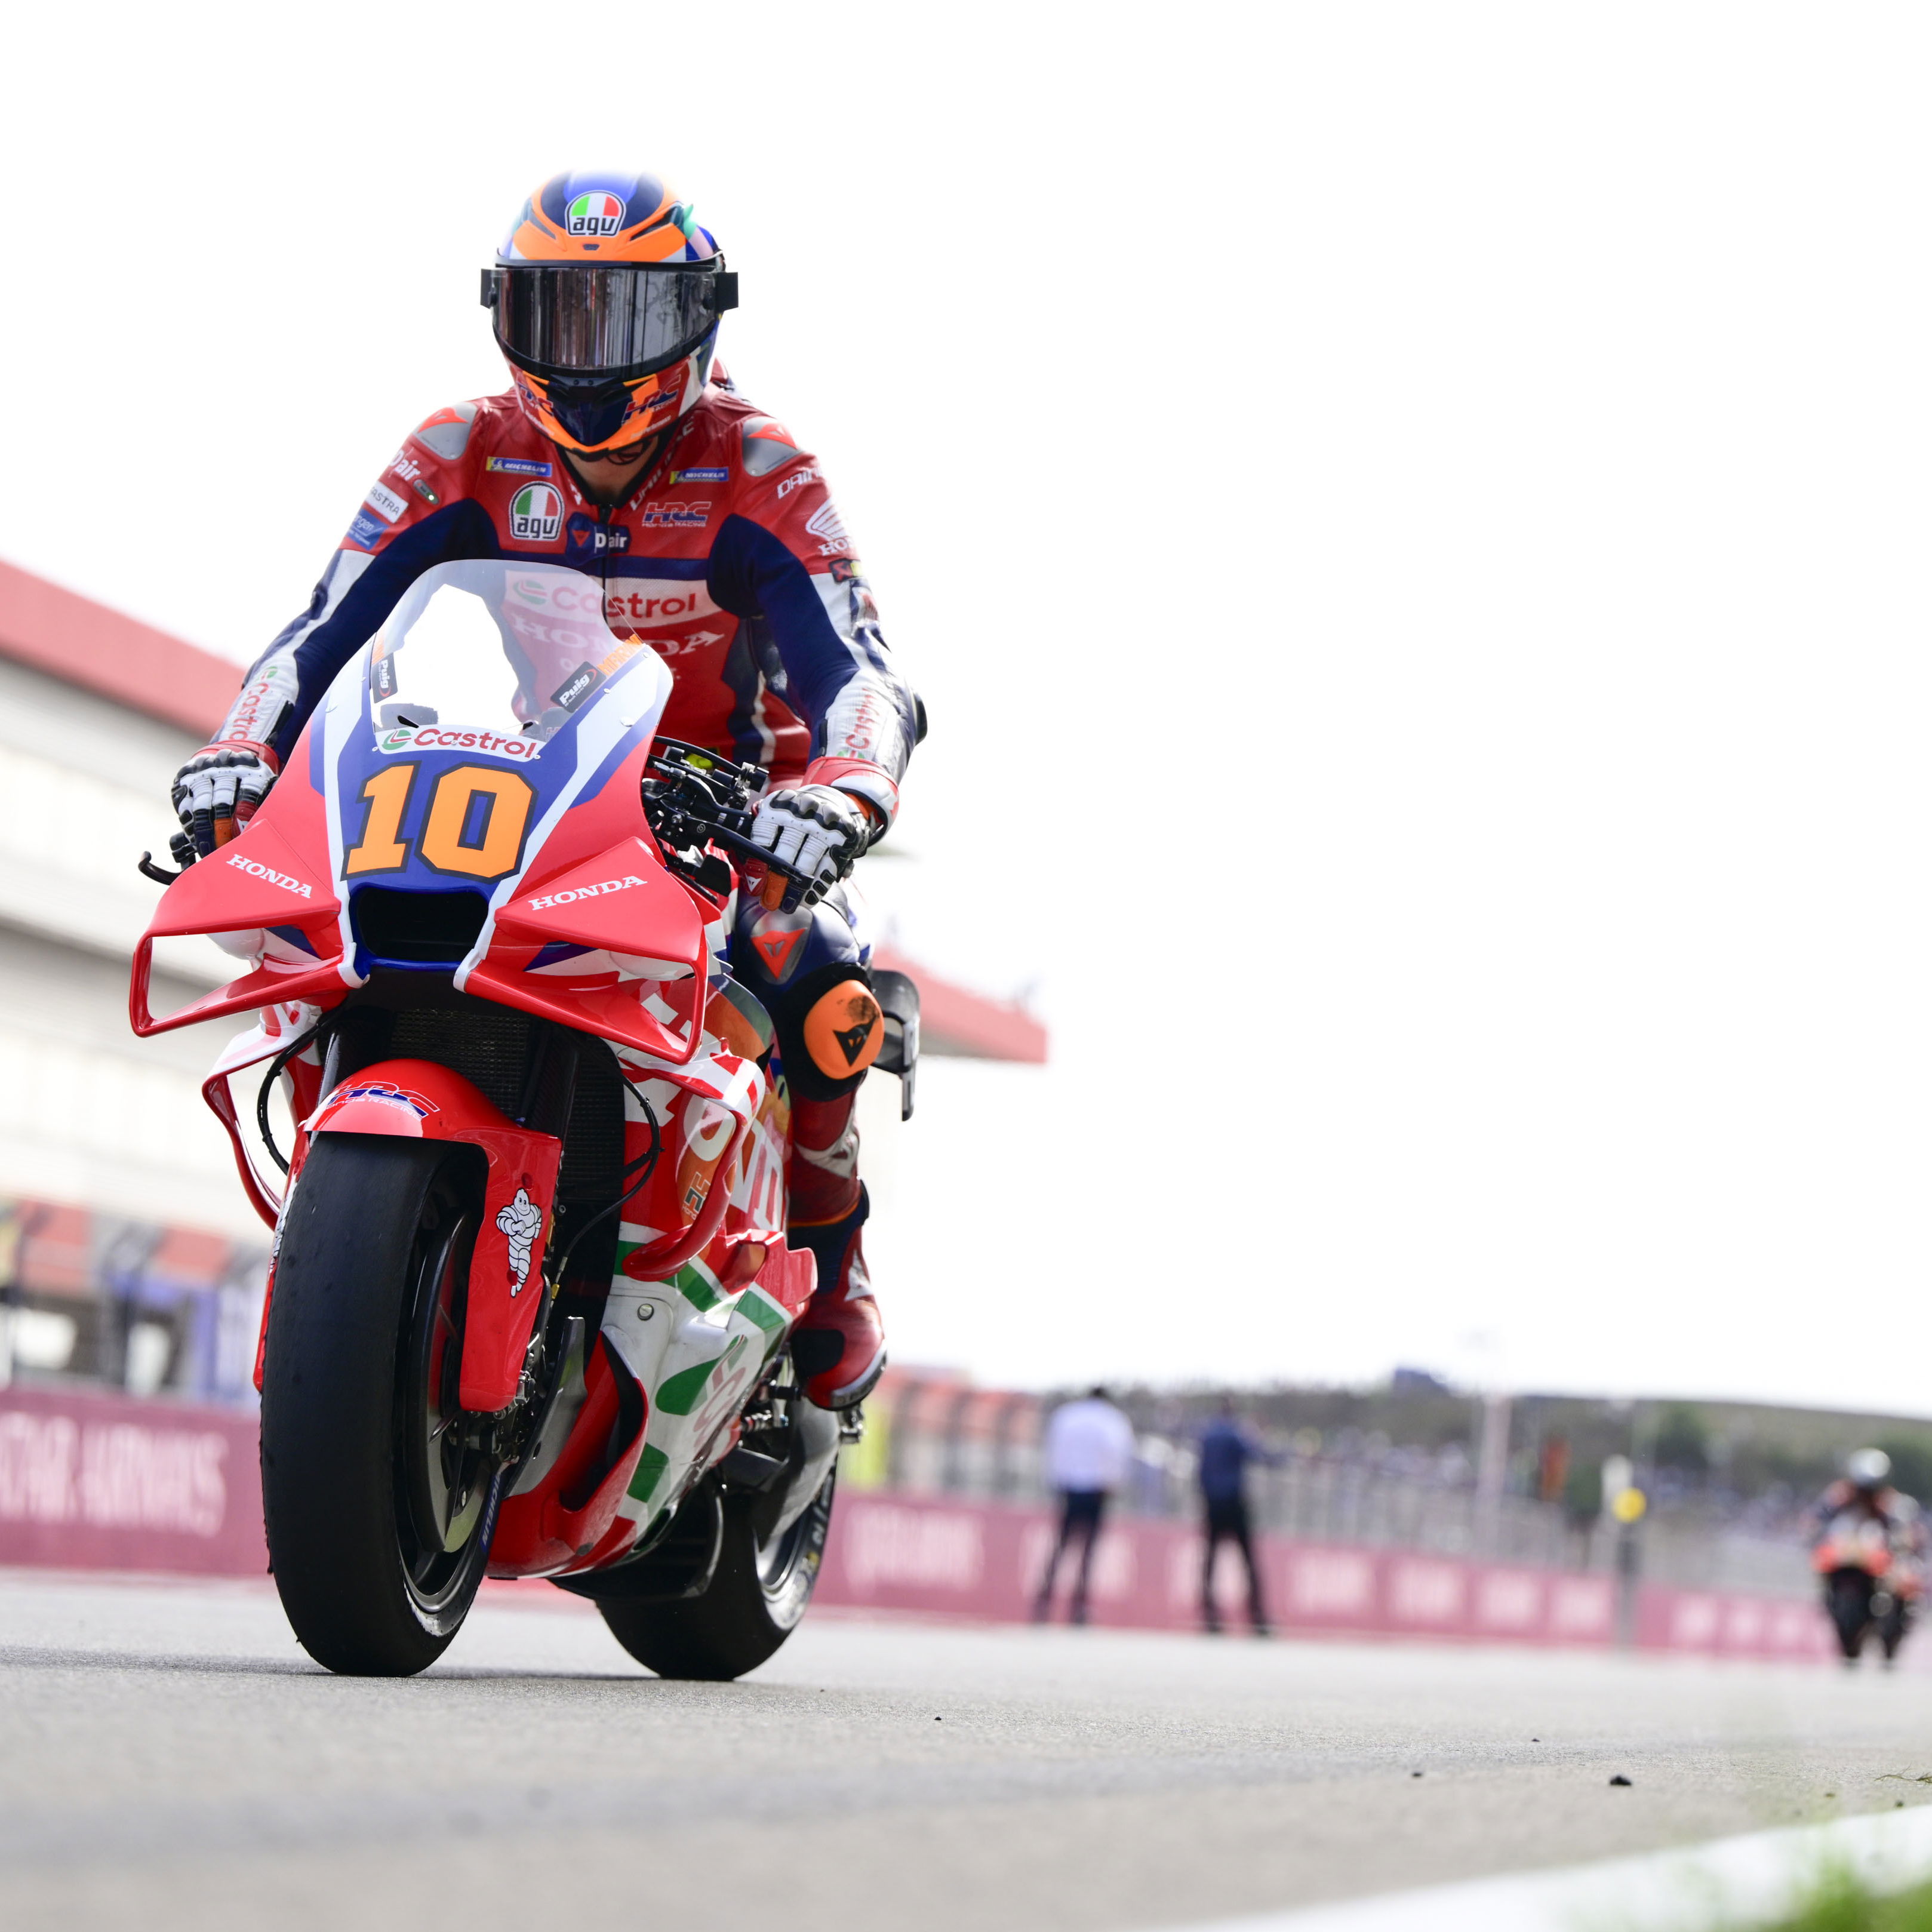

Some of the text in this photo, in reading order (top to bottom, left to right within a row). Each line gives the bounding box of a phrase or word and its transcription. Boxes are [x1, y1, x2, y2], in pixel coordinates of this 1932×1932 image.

[573, 217, 616, 235] agv
[517, 517, 555, 538] agv
[642, 501, 712, 523] HRC
[551, 586, 696, 620] Castrol
[381, 659, 390, 688] Puig
[559, 674, 590, 705] Puig
[229, 682, 270, 741] Castro
[414, 728, 537, 758] Castrol
[342, 761, 537, 882] 10
[226, 854, 312, 899] HONDA
[528, 876, 648, 910] HONDA
[328, 1081, 441, 1118] HRC
[368, 1097, 422, 1122] RACING
